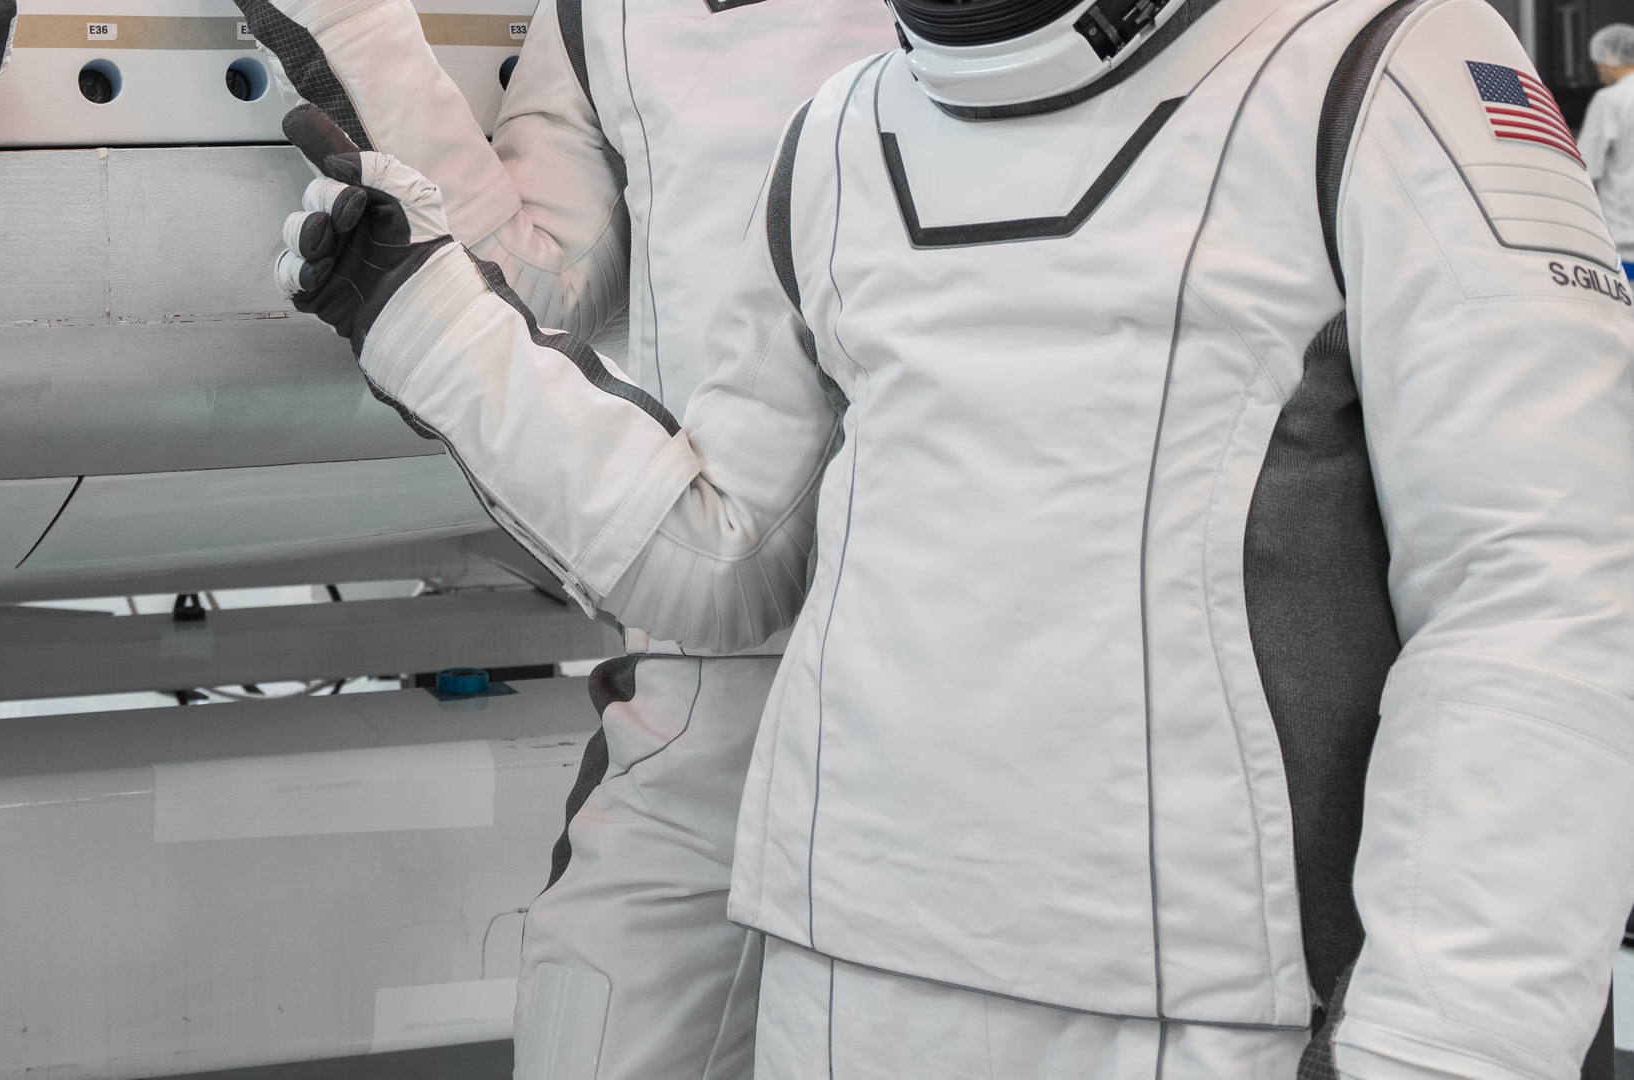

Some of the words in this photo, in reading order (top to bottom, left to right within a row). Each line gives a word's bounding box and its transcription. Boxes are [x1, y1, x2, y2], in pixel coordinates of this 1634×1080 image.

[89, 25, 109, 35] E36
[510, 24, 528, 35] E33
[1549, 262, 1632, 306] S.GILLIS
